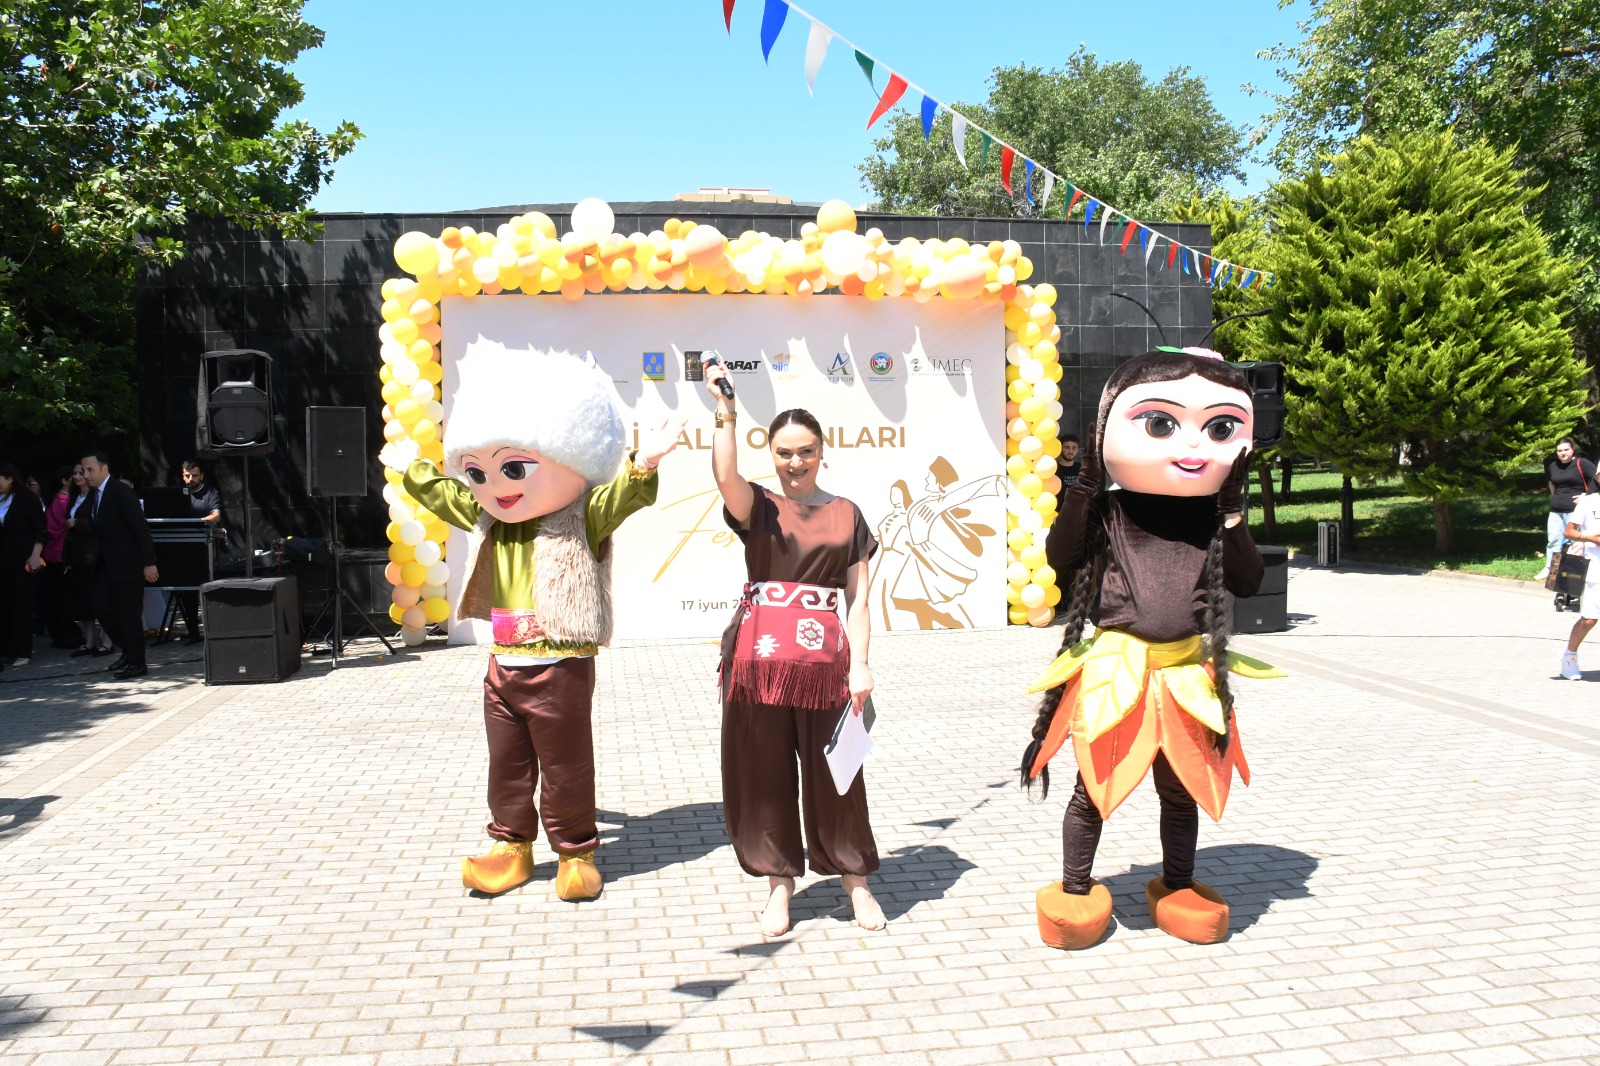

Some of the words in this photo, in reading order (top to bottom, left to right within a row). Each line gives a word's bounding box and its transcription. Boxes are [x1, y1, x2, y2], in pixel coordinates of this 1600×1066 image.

[932, 358, 972, 371] IMEC
[746, 426, 906, 449] ONLARI
[681, 600, 695, 611] 17
[698, 599, 728, 613] iyun
